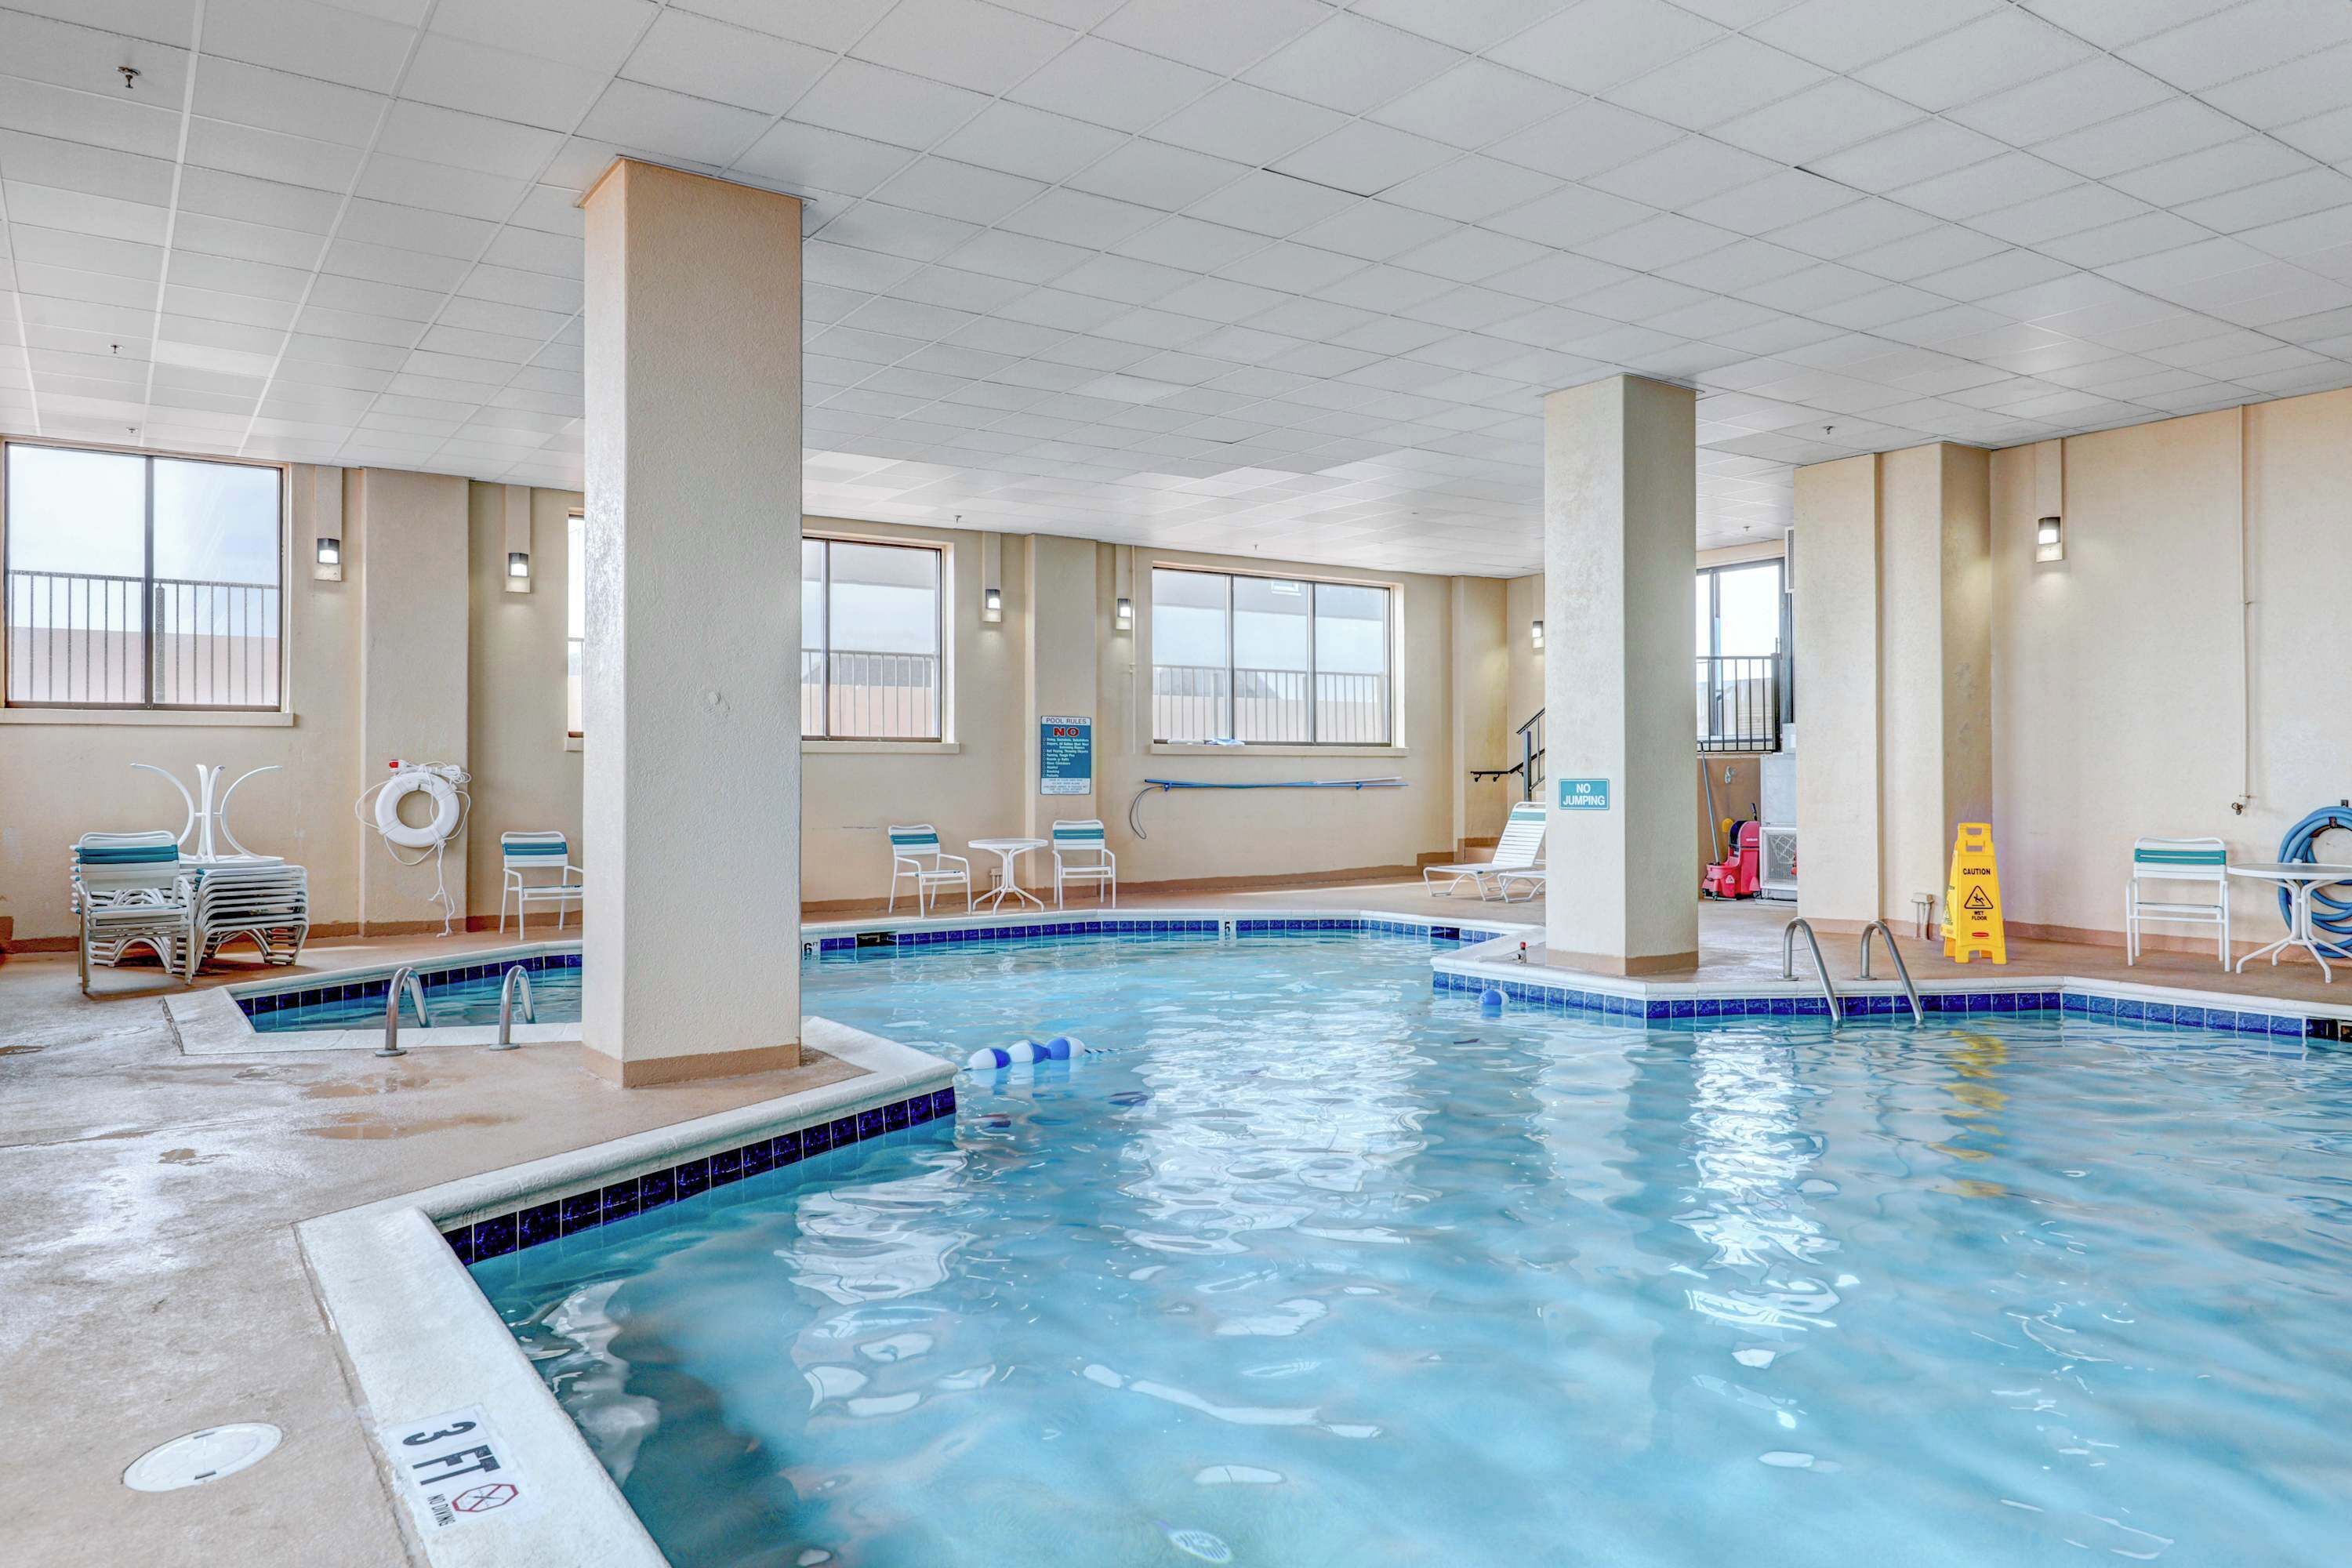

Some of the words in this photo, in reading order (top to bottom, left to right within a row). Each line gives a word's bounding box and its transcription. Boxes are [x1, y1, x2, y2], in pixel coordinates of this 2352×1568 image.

[1053, 727, 1080, 736] NO
[1576, 783, 1592, 793] NO
[1563, 795, 1606, 806] JUMPING
[804, 942, 812, 956] 6
[402, 1421, 477, 1446] 3
[412, 1444, 501, 1486] FT
[426, 1494, 445, 1504] NO
[431, 1504, 456, 1526] DIVING
